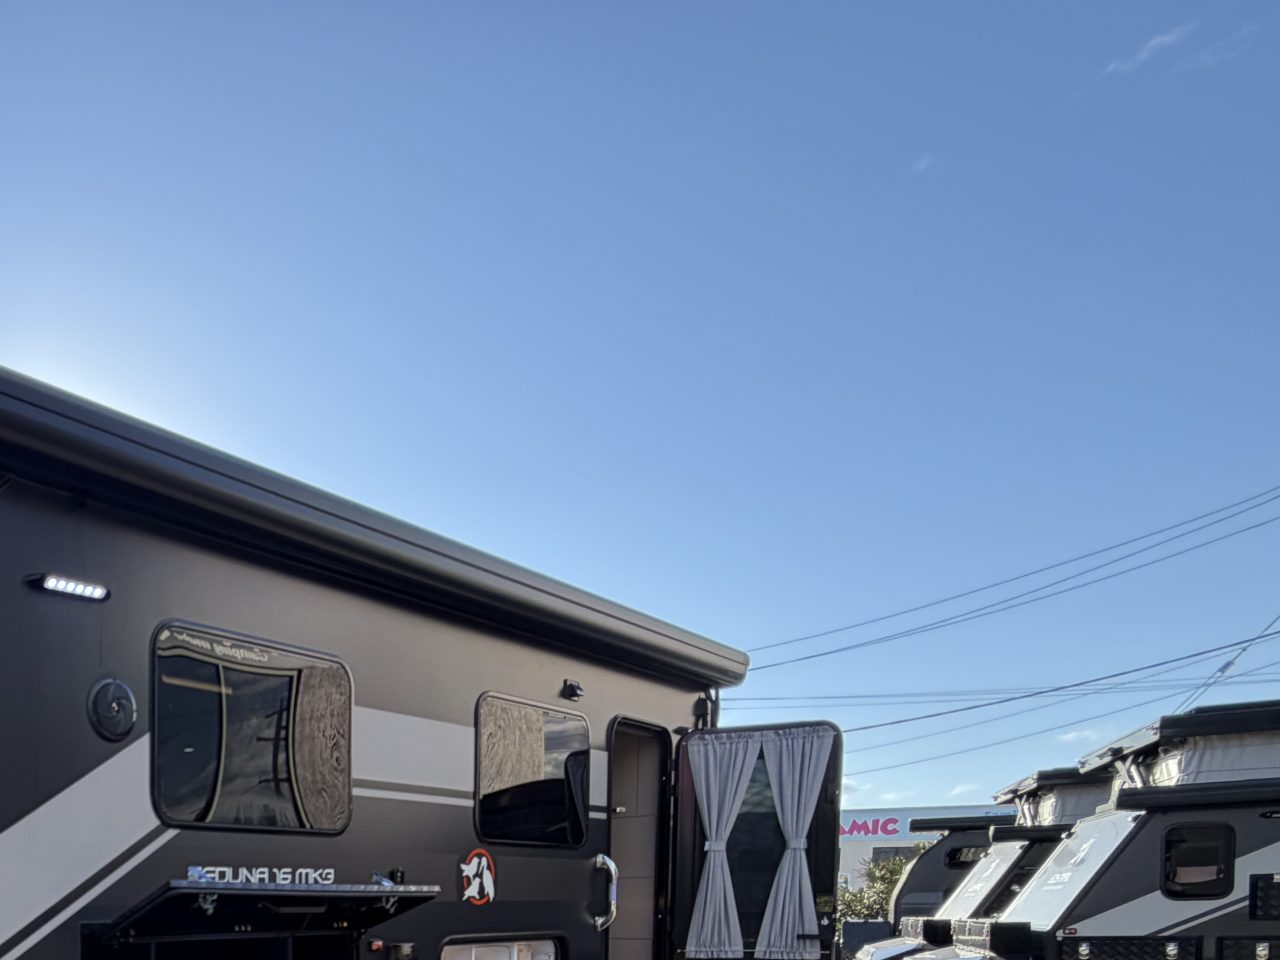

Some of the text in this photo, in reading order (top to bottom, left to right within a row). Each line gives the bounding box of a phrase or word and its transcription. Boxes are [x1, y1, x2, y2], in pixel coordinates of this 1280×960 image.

[187, 866, 335, 885] EDUNA 16 MK3
